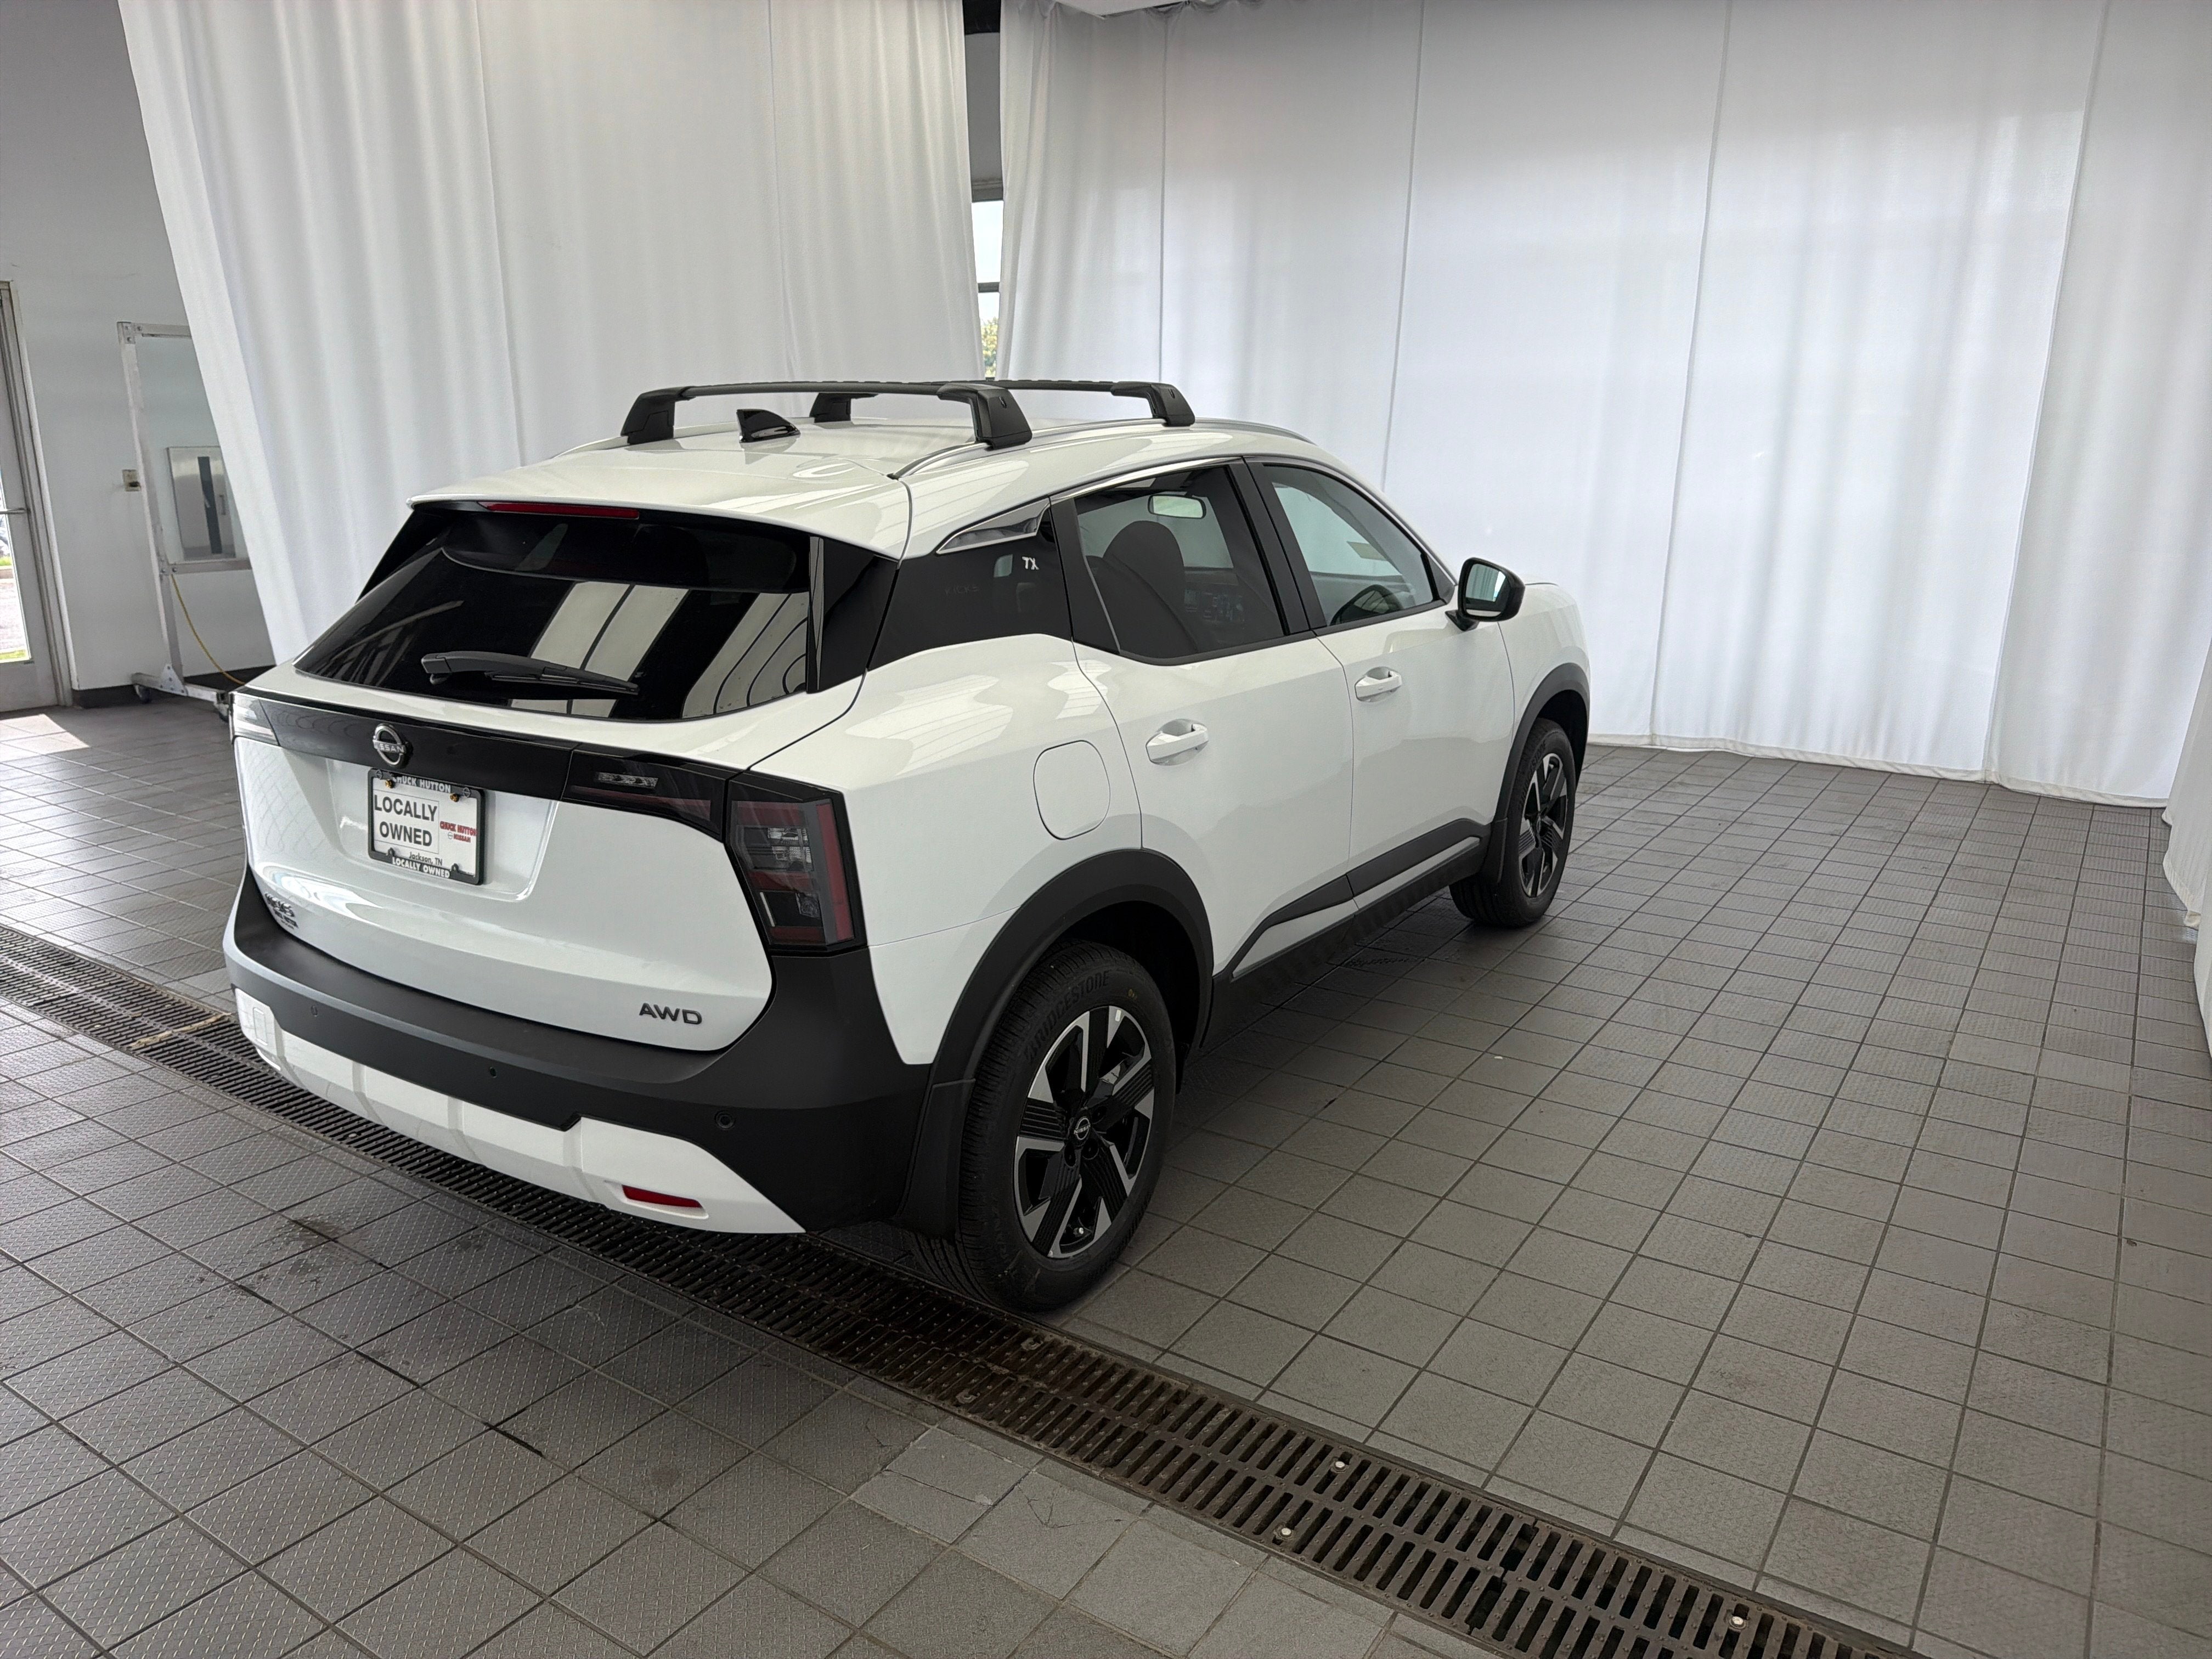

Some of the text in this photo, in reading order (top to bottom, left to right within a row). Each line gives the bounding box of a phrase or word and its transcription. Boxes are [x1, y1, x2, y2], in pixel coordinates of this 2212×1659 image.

[1022, 556, 1040, 571] TX
[419, 780, 452, 793] HUTTON
[374, 794, 437, 822] LOCALLY
[380, 821, 432, 847] OWNED
[392, 856, 450, 878] LOCALLY OWNED
[409, 851, 443, 866] Jackson, TN
[639, 1003, 702, 1025] AWD
